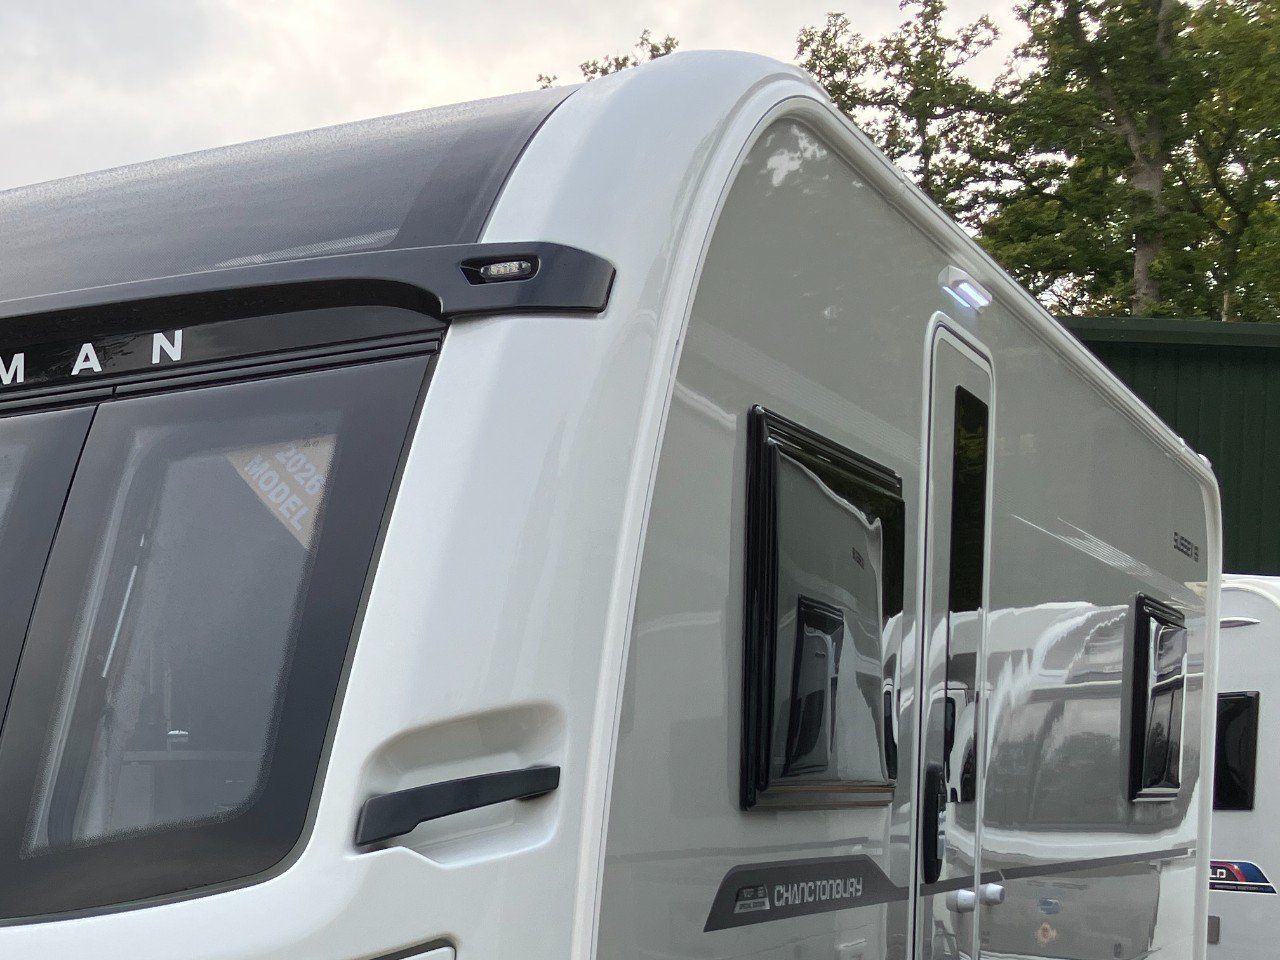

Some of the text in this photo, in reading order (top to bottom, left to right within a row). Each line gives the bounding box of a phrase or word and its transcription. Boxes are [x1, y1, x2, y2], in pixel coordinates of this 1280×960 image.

[244, 454, 310, 531] MODEL
[275, 443, 325, 495] 2026
[774, 877, 863, 906] CHANCTONBURY
